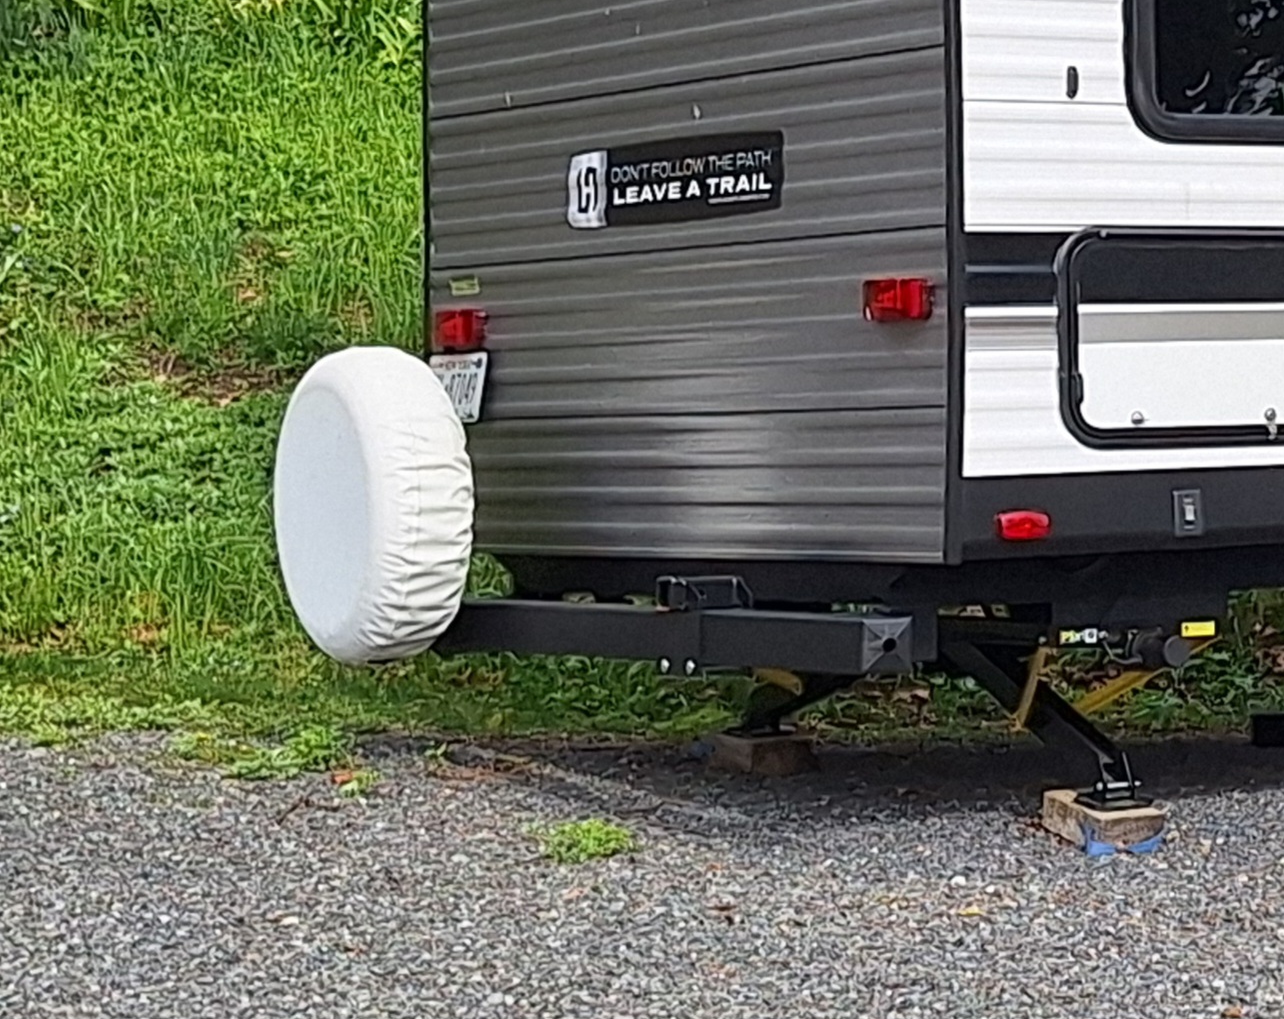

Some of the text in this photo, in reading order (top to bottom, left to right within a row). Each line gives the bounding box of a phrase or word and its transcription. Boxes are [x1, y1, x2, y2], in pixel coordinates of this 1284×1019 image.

[651, 156, 706, 178] FOLLOW
[706, 153, 735, 173] THE
[735, 149, 773, 171] PATH
[612, 171, 773, 205] LEAVE A TRAIL
